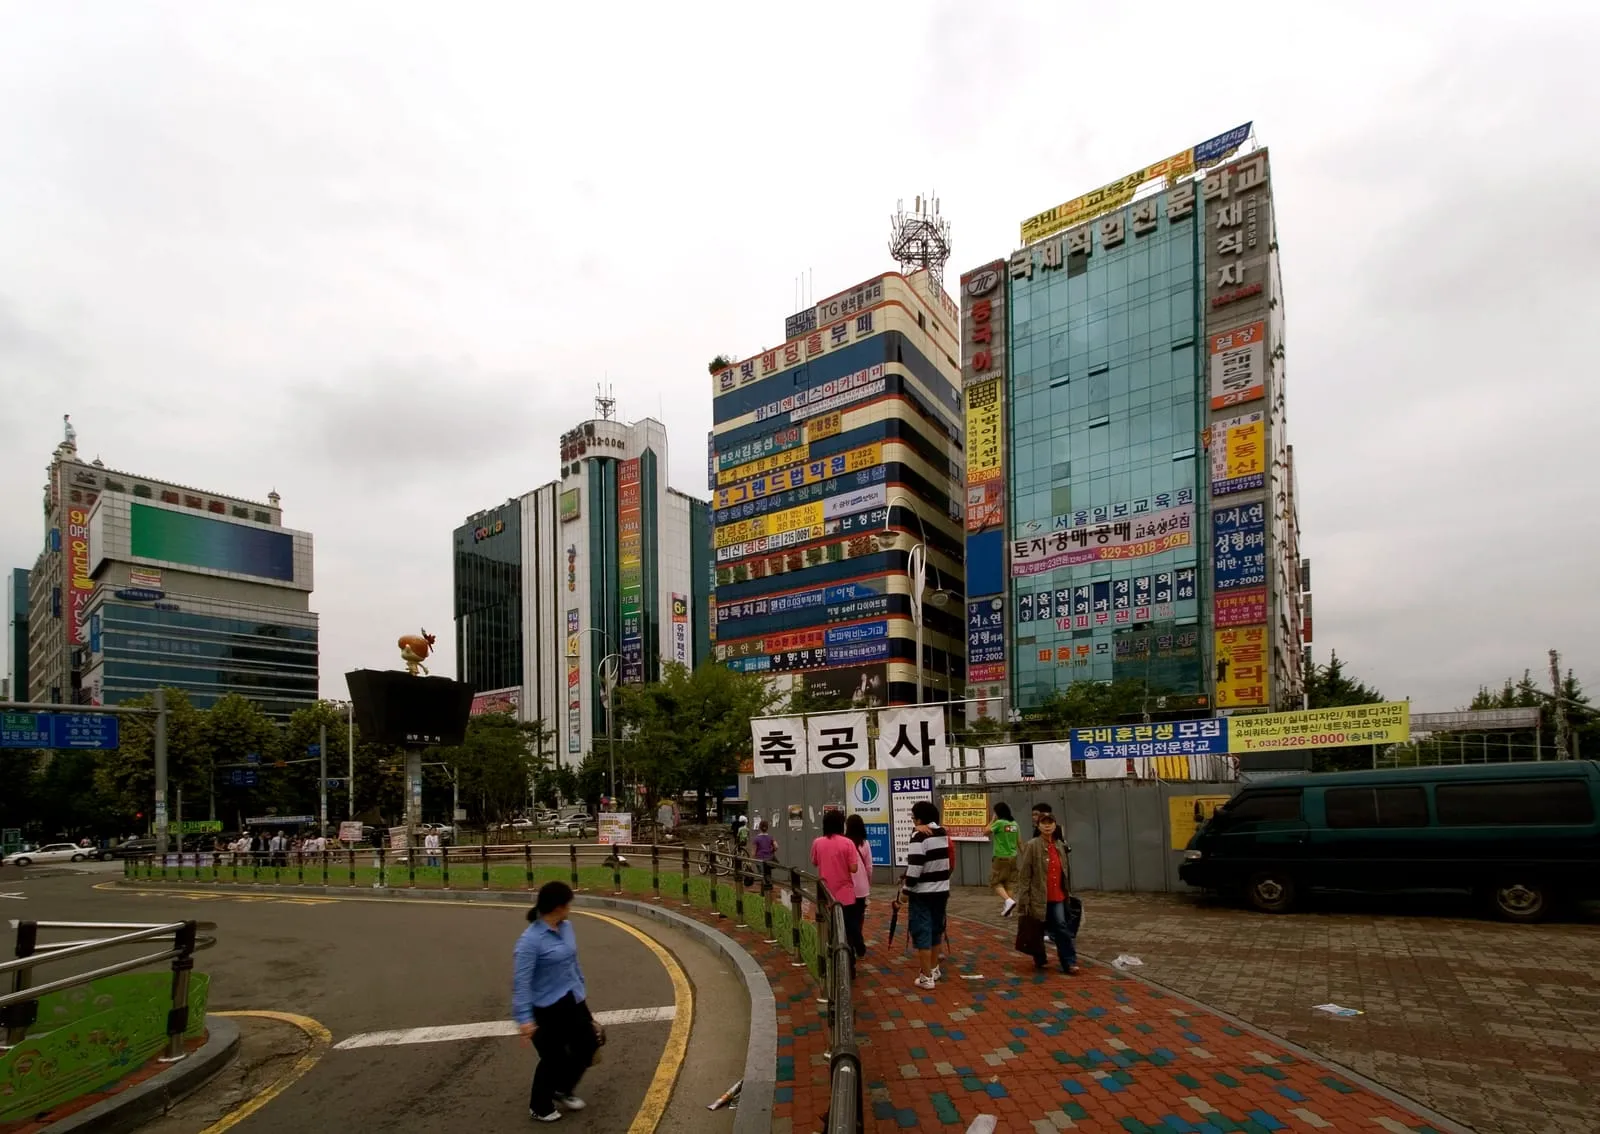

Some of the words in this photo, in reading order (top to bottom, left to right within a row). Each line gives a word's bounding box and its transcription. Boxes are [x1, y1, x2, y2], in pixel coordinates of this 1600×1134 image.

[1215, 200, 1246, 289] 재직자
[821, 302, 838, 320] TG
[1223, 391, 1251, 406] 2F
[1231, 426, 1259, 475] 부동산
[1055, 488, 1193, 529] 서울일보교육원
[1135, 512, 1191, 540] 교육생모집
[1215, 531, 1265, 554] 성형외과
[1114, 570, 1195, 594] 성형외과
[1216, 575, 1265, 588] 327-2002
[674, 601, 687, 616] 6F
[1037, 599, 1109, 620] 성형외과
[1114, 589, 1171, 609] 전문의
[970, 651, 1003, 663] 327-2002
[1076, 729, 1112, 744] 국비
[1114, 723, 1174, 743] 훈련생
[1178, 720, 1221, 739] 모집
[1101, 739, 1210, 758] 국제직업전문학교
[892, 778, 931, 792] 공사안내
